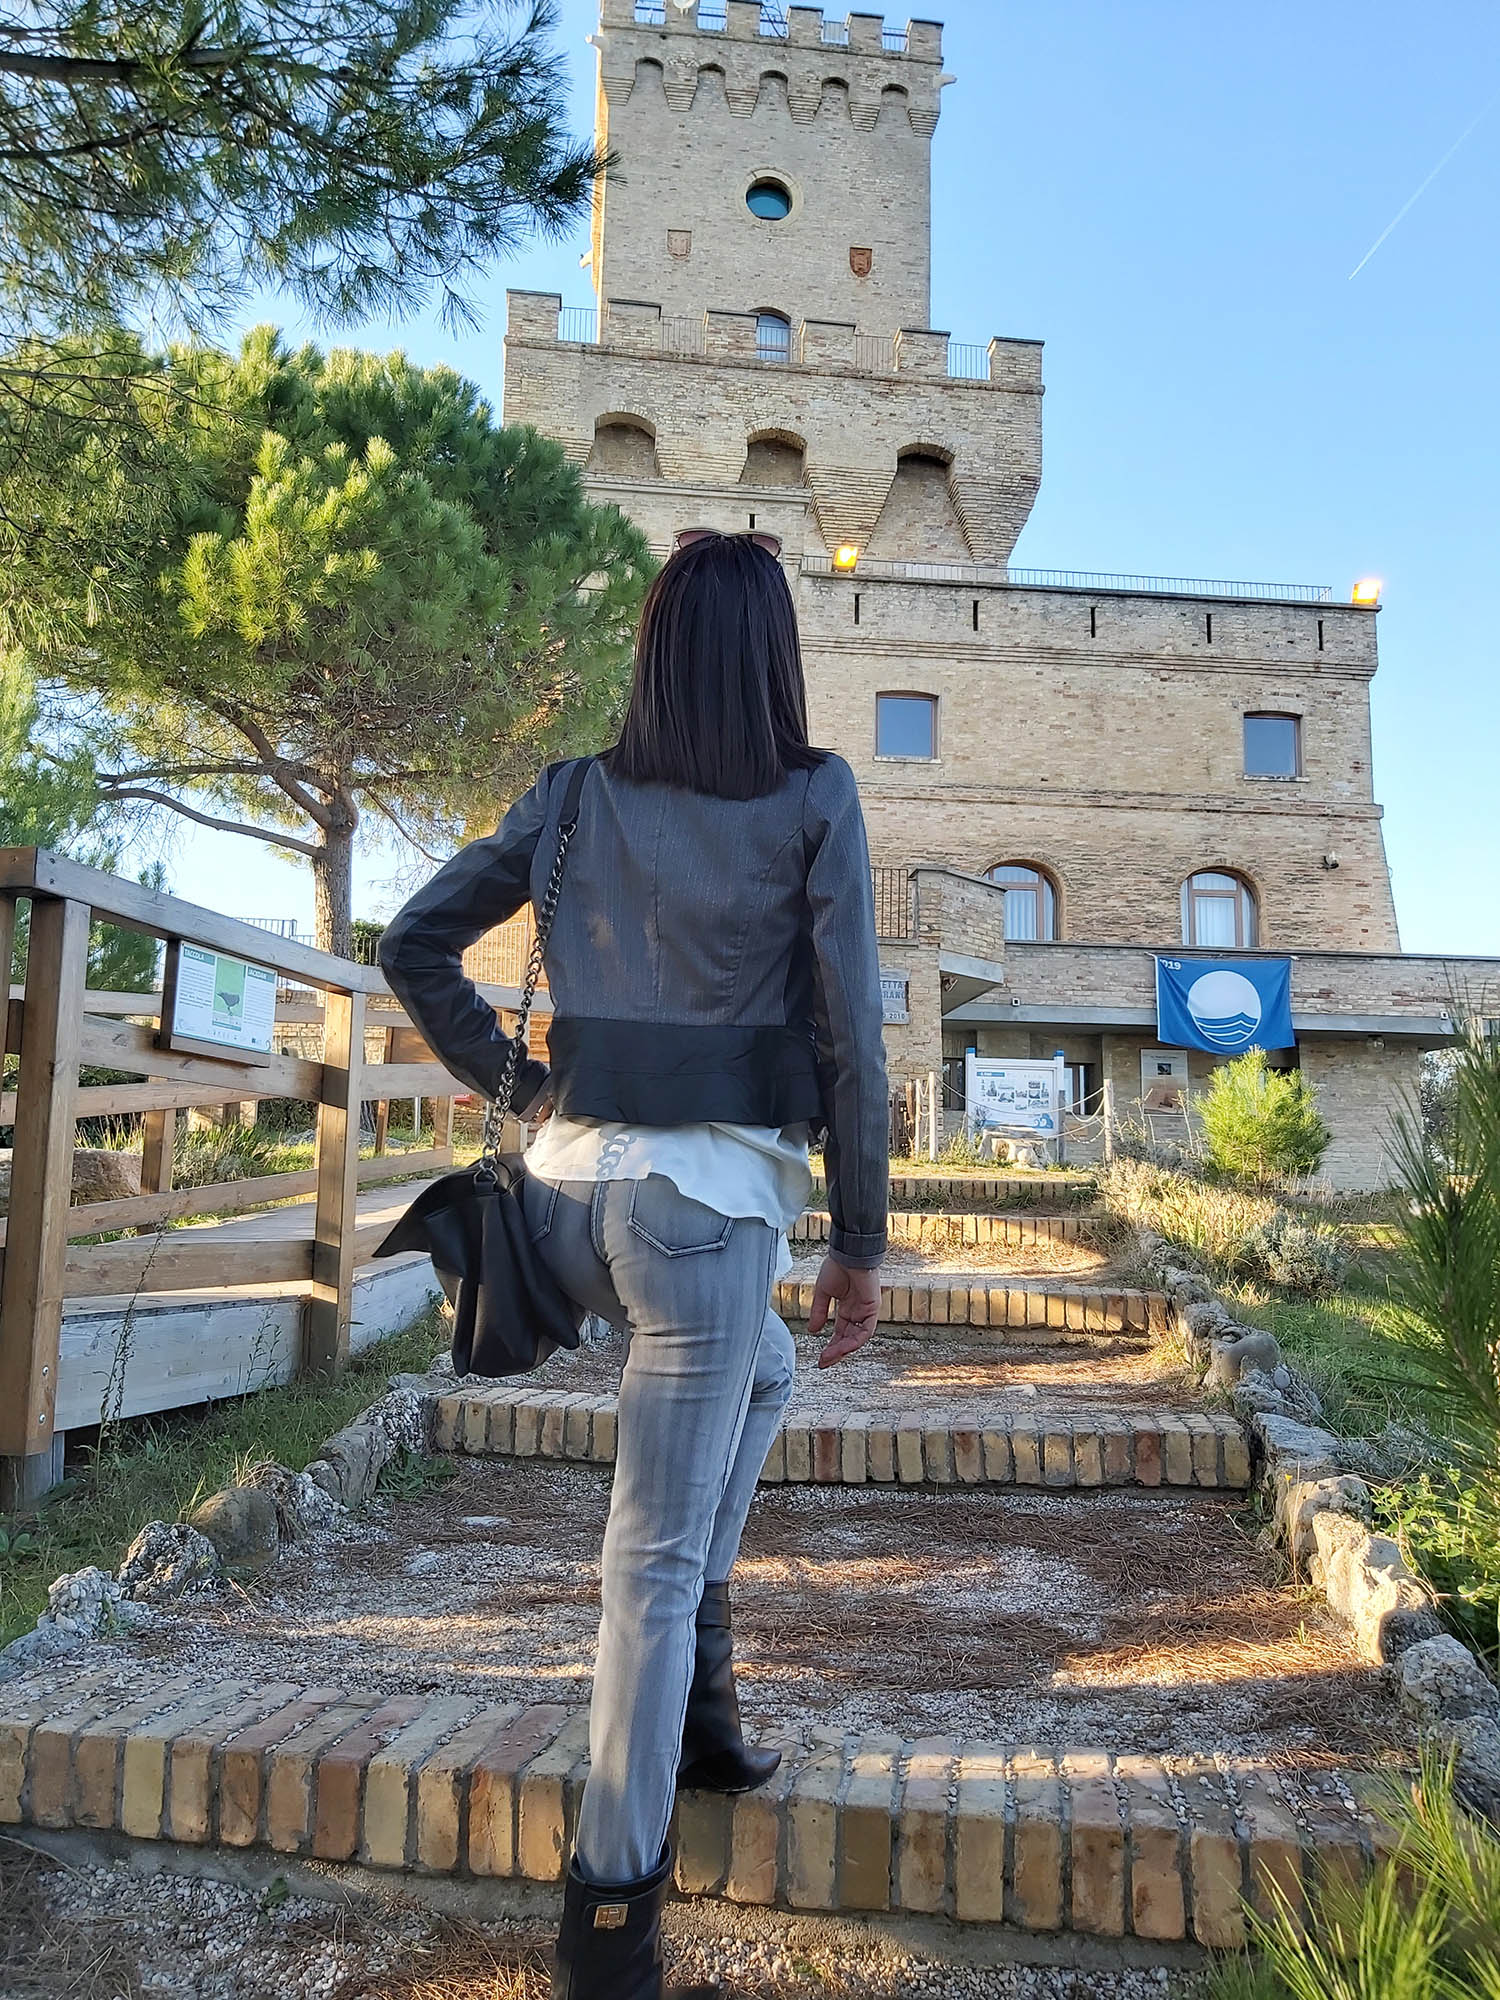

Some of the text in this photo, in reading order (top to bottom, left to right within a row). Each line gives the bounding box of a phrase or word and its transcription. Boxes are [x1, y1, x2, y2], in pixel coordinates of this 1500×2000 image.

[1159, 958, 1182, 970] 019
[882, 981, 903, 989] ETTA
[883, 991, 905, 999] RANO
